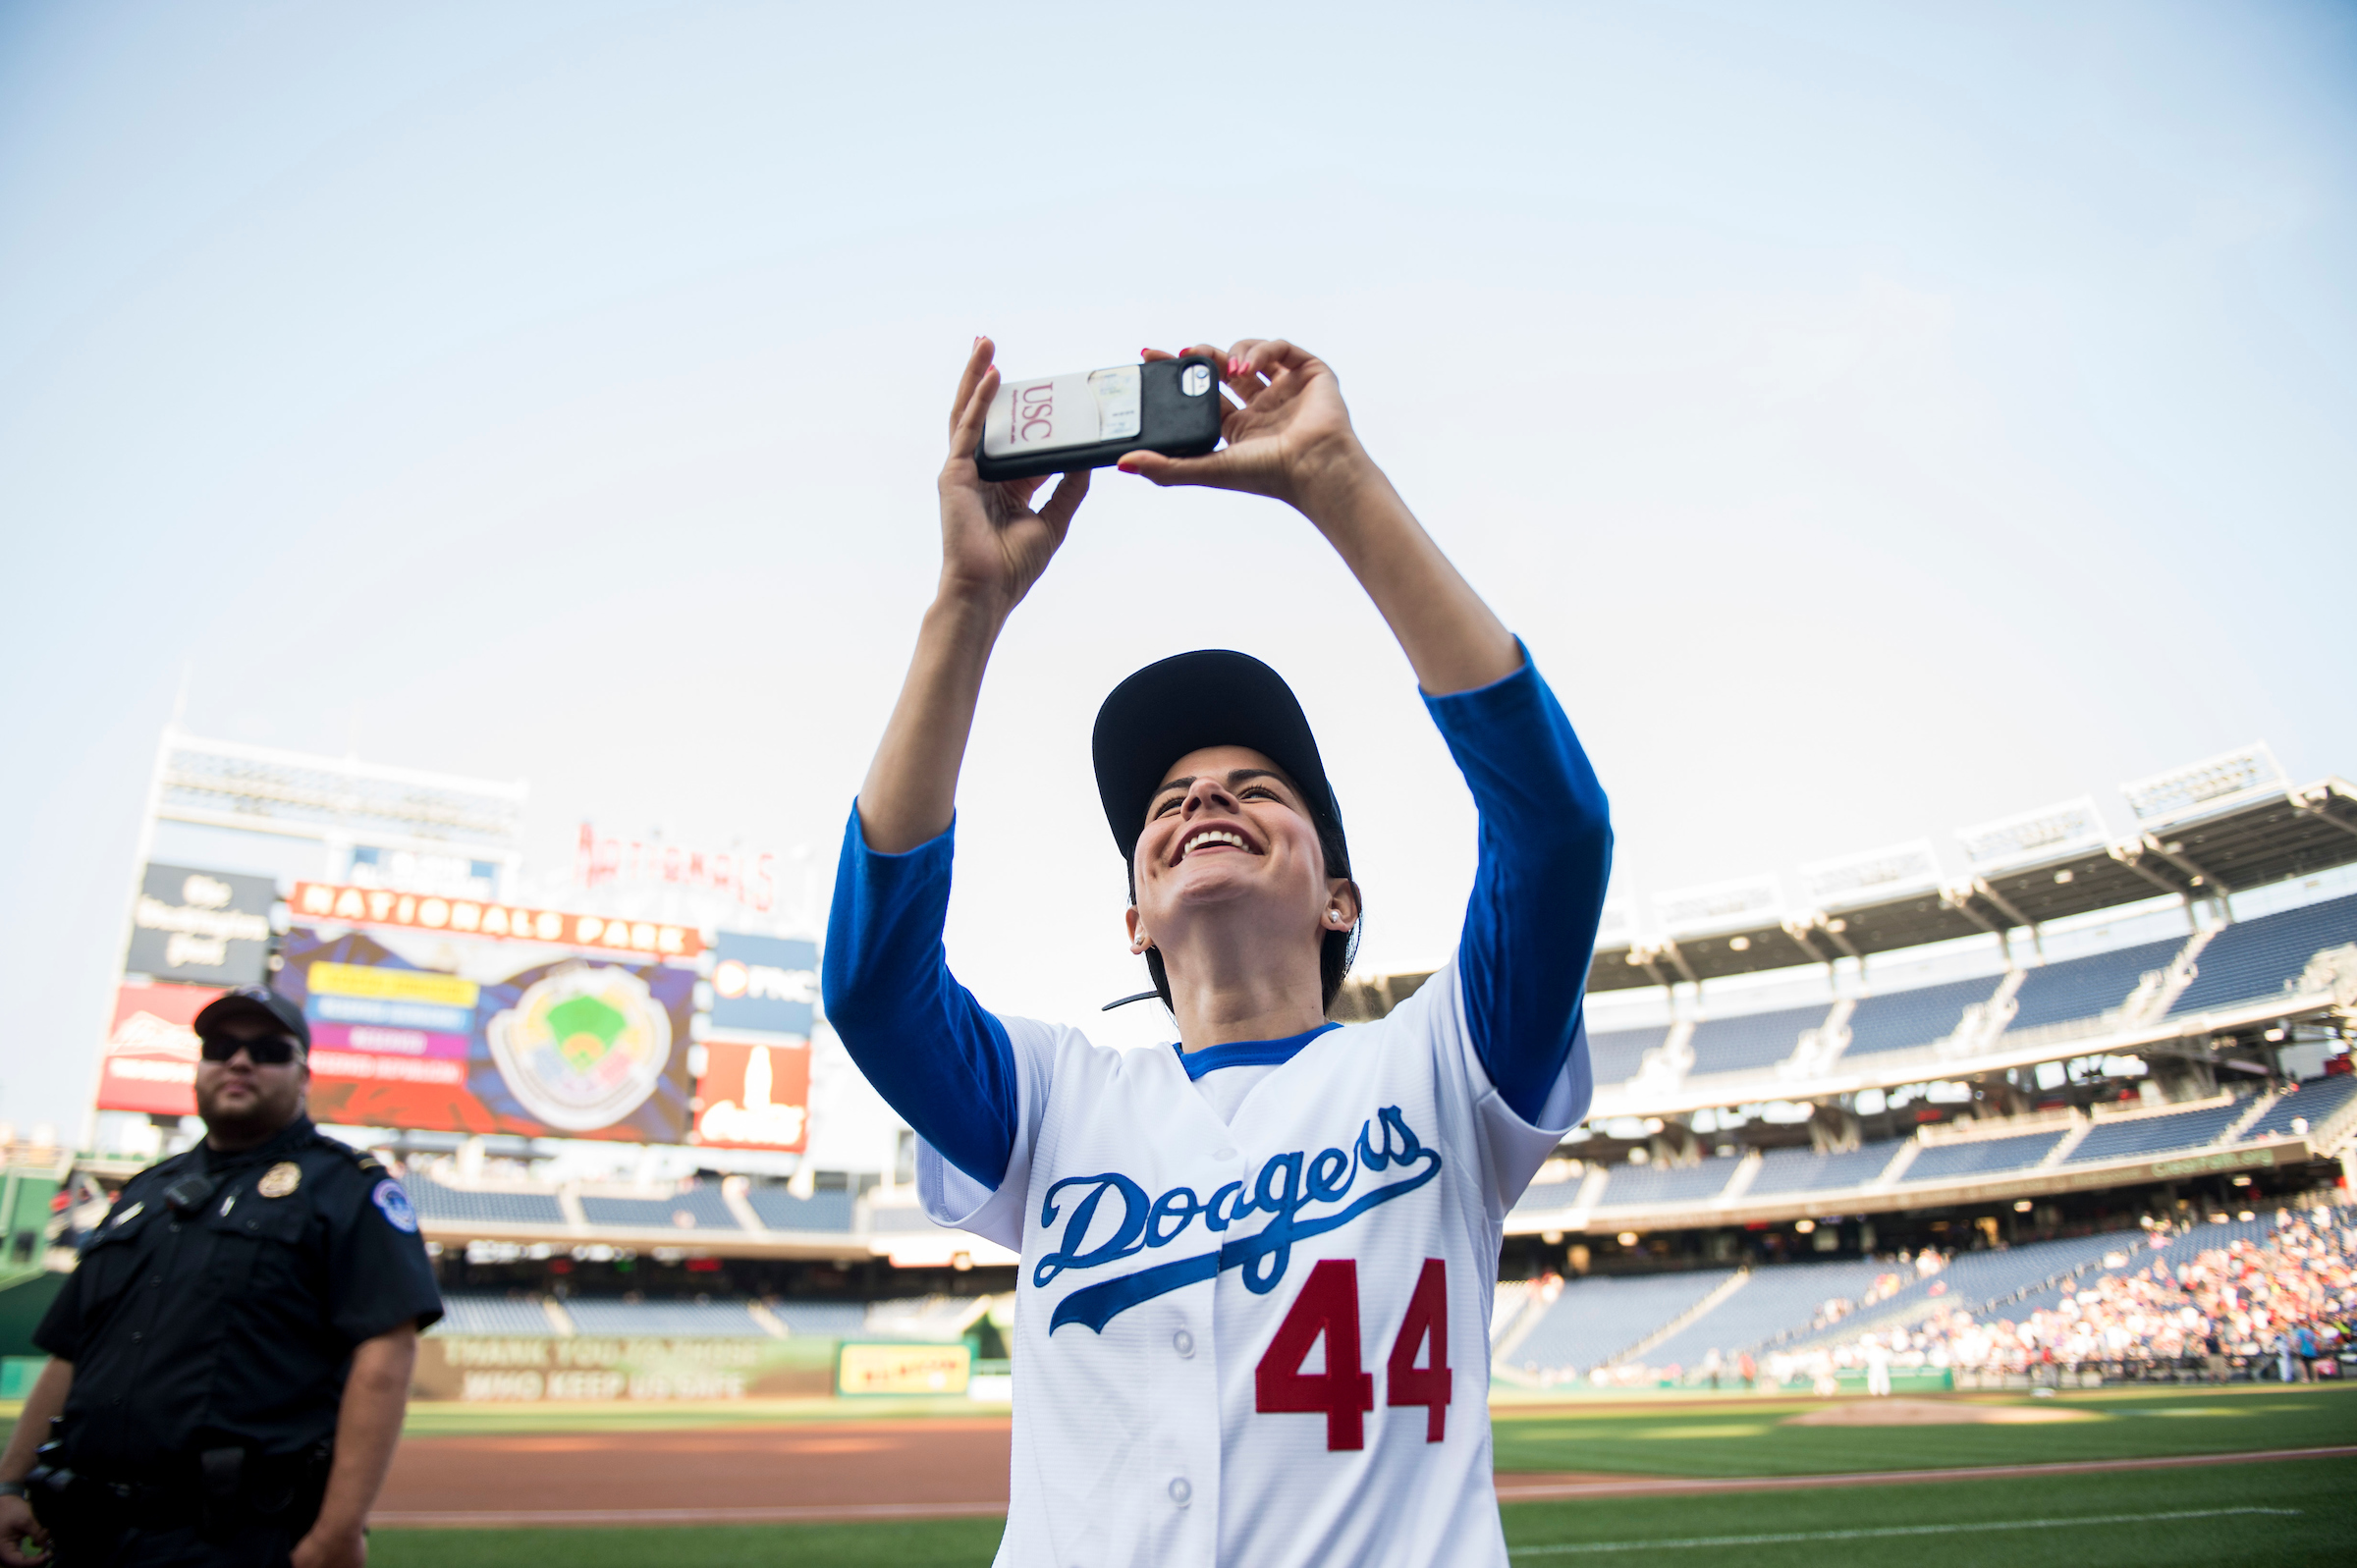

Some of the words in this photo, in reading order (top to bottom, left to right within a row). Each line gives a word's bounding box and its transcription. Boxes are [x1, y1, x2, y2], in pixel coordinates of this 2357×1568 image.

[1021, 381, 1053, 442] USC
[303, 885, 563, 941] NATIONALS
[576, 915, 686, 954] PARK
[1033, 1106, 1441, 1295] Dodgers
[1256, 1258, 1452, 1451] 44
